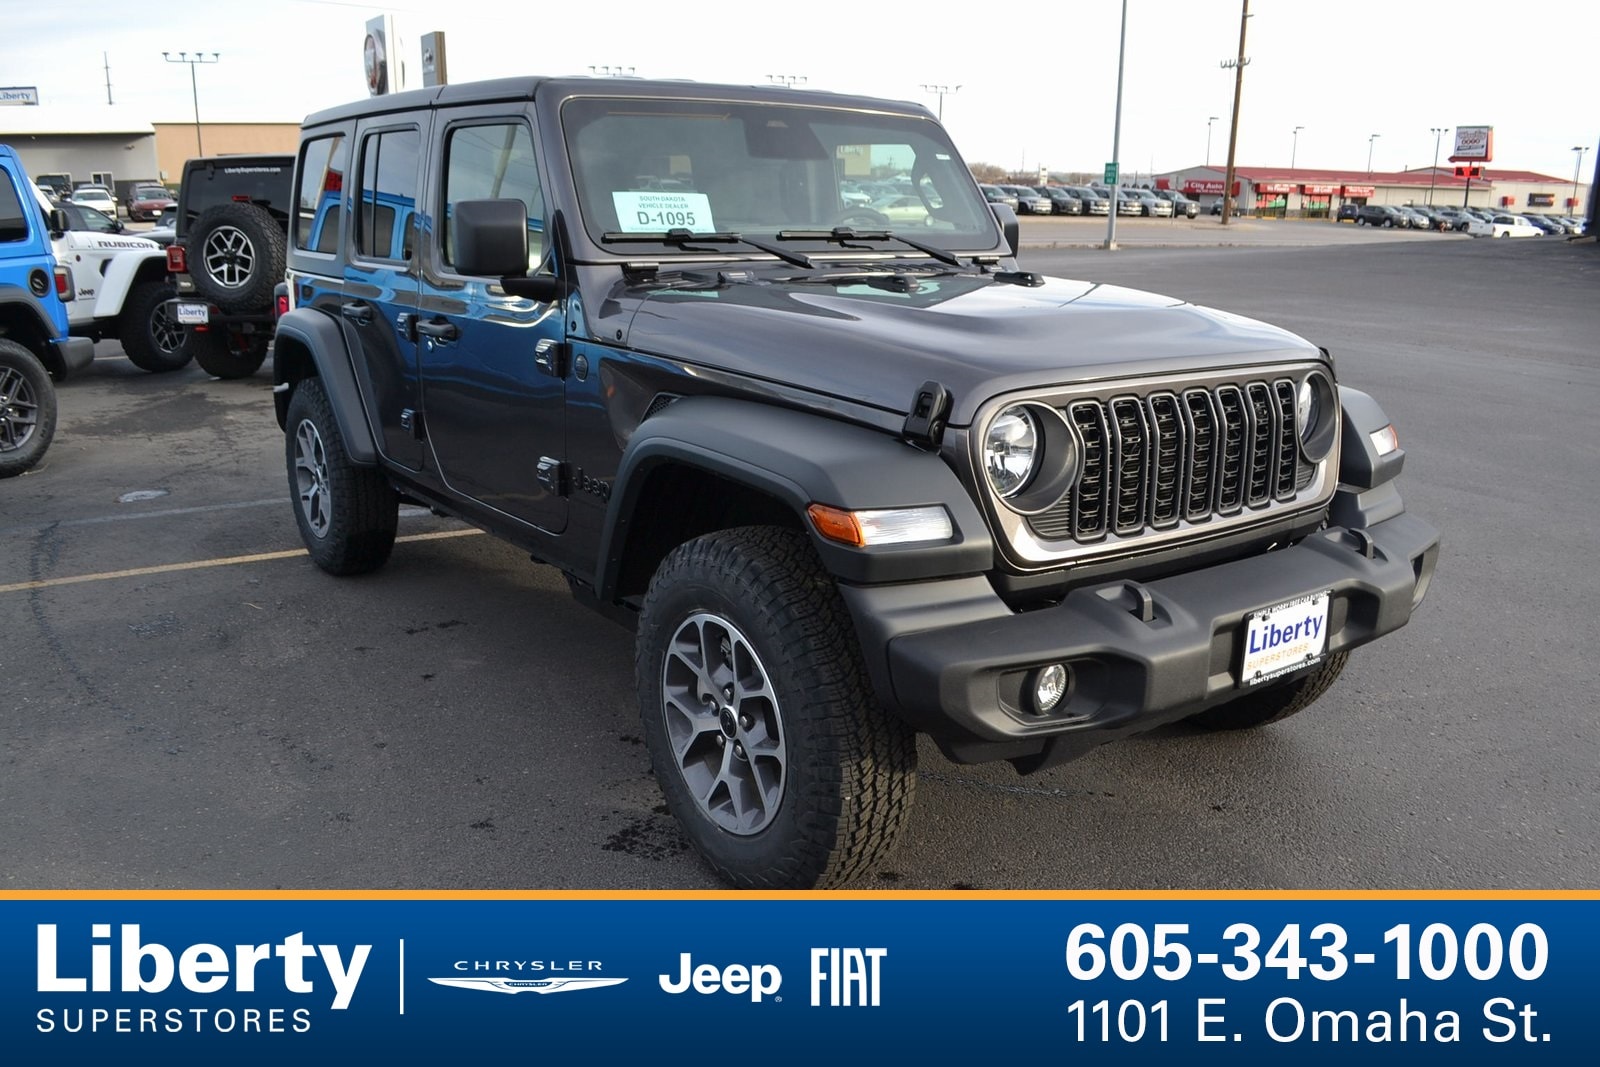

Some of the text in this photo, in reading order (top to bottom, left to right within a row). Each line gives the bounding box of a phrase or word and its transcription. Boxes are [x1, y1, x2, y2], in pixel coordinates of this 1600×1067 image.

[637, 211, 696, 226] D-1095
[97, 240, 154, 249] RUBICON
[79, 288, 95, 296] Jeep
[178, 307, 206, 317] Liberty
[1249, 615, 1324, 654] Liberty
[1246, 642, 1310, 671] SUPERSTORES
[1249, 656, 1321, 686] libertysuperstores.com
